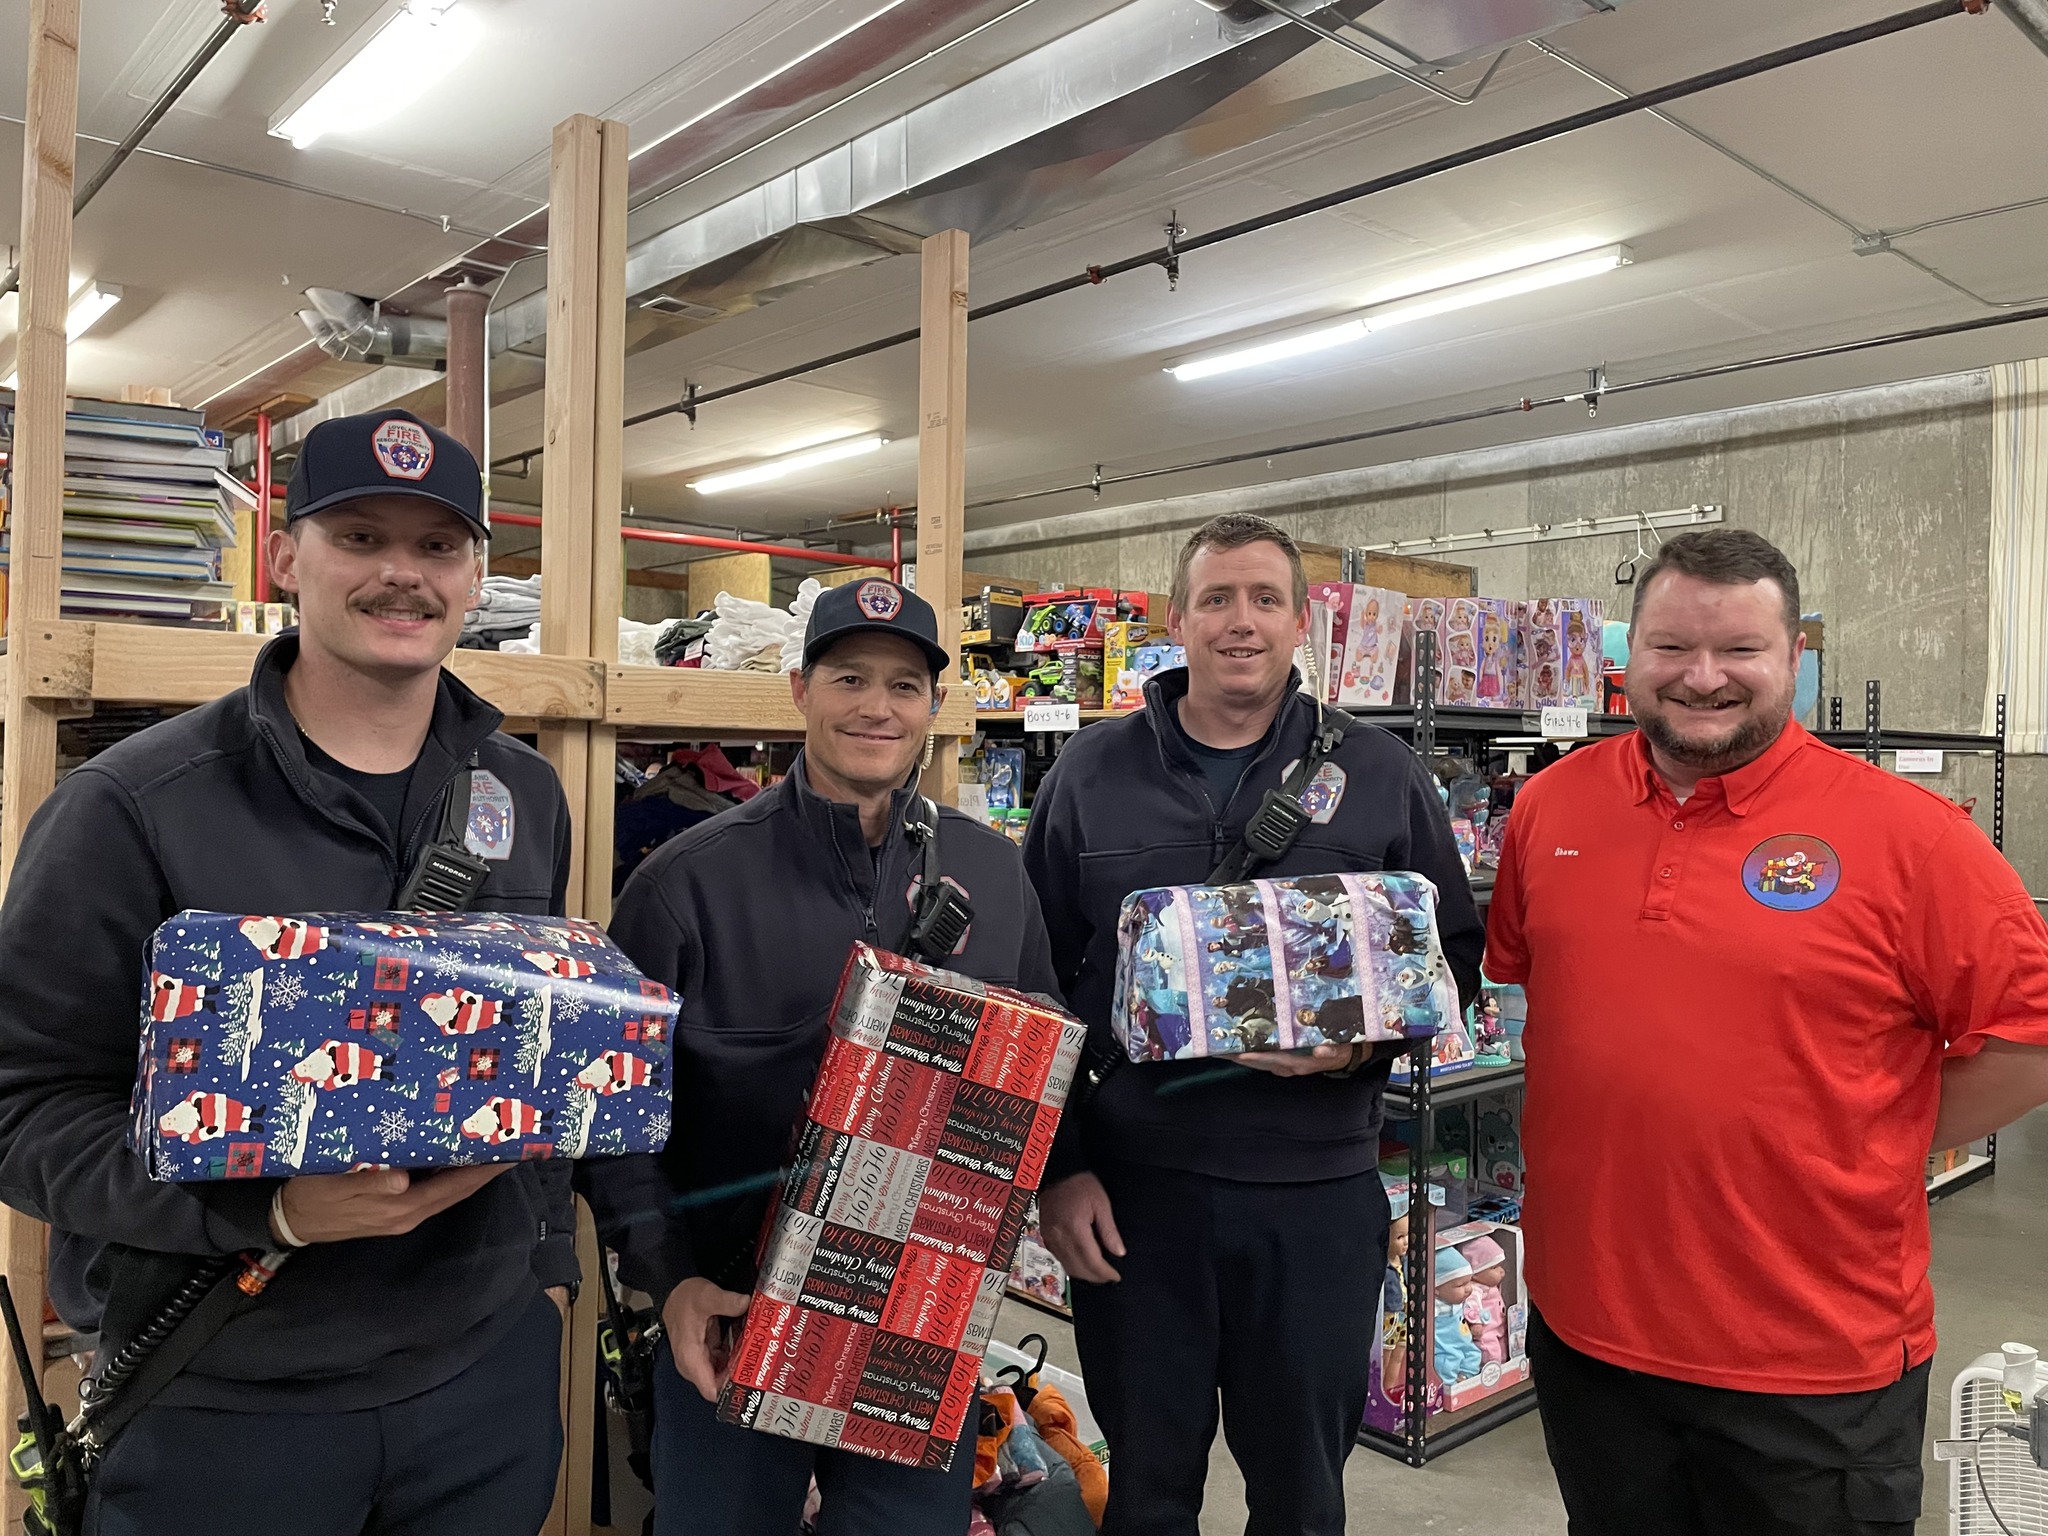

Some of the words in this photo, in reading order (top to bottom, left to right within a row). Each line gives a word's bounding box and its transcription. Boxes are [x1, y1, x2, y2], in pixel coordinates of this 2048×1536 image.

[387, 430, 422, 443] FIRE
[867, 587, 892, 595] FIRE
[1020, 636, 1034, 646] KID
[1055, 708, 1070, 720] 4-6
[1567, 715, 1581, 728] 4-6
[472, 782, 496, 794] RE
[432, 861, 472, 881] MOTOROLA
[897, 996, 945, 1022] Christmas
[947, 1008, 979, 1031] Merry
[981, 1001, 1000, 1033] Merry
[892, 1011, 940, 1034] Christmas
[939, 1024, 973, 1044] Merry
[1006, 1008, 1030, 1041] Merry
[1041, 1020, 1062, 1053] Merry
[883, 1041, 930, 1064] Christmas
[930, 1053, 963, 1074] Merry
[966, 1035, 989, 1081] Christmas
[855, 1049, 878, 1085] Merry
[869, 1055, 896, 1104] Christmas
[994, 1042, 1020, 1091] Christmas
[1027, 1052, 1051, 1100] Christmas
[842, 1085, 866, 1132] Christmas
[907, 1118, 927, 1151] Merry
[918, 1071, 942, 1118] Christmas
[858, 1107, 882, 1139] Merry
[944, 1118, 991, 1141] Christmas
[827, 1132, 850, 1168] Merry
[990, 1131, 1024, 1151] Merry
[840, 1138, 868, 1187] Christmas
[934, 1148, 981, 1171] Christmas
[981, 1159, 1014, 1180] Merry
[814, 1168, 838, 1216] Christmas
[866, 1199, 887, 1232] Merry
[877, 1150, 901, 1198] Christmas
[921, 1185, 970, 1211] Christmas
[830, 1190, 854, 1223] Merry
[916, 1200, 964, 1224] Christmas
[971, 1196, 1004, 1220] Merry
[963, 1213, 997, 1233] Merry
[907, 1231, 954, 1255] Christmas
[954, 1242, 988, 1264] Merry
[811, 1246, 861, 1272] Christmas
[863, 1257, 896, 1281] Merry
[898, 1246, 919, 1280] Merry
[924, 1253, 949, 1287] Merry
[807, 1262, 856, 1285] Christmas
[855, 1274, 889, 1295] Merry
[961, 1265, 982, 1299] Merry
[797, 1293, 845, 1316] Christmas
[845, 1304, 879, 1325] Merry
[883, 1282, 907, 1330] Christmas
[911, 1289, 939, 1339] Christmas
[769, 1301, 792, 1338] Merry
[783, 1307, 811, 1358] Christmas
[946, 1299, 970, 1348] Christmas
[755, 1338, 780, 1387] Christmas
[821, 1372, 842, 1406] Merry
[833, 1322, 858, 1371] Christmas
[771, 1361, 796, 1395] Merry
[859, 1369, 908, 1393] Christmas
[907, 1382, 942, 1402] Merry
[738, 1388, 763, 1426] Merry
[849, 1401, 898, 1424] Christmas
[898, 1412, 932, 1433] Merry
